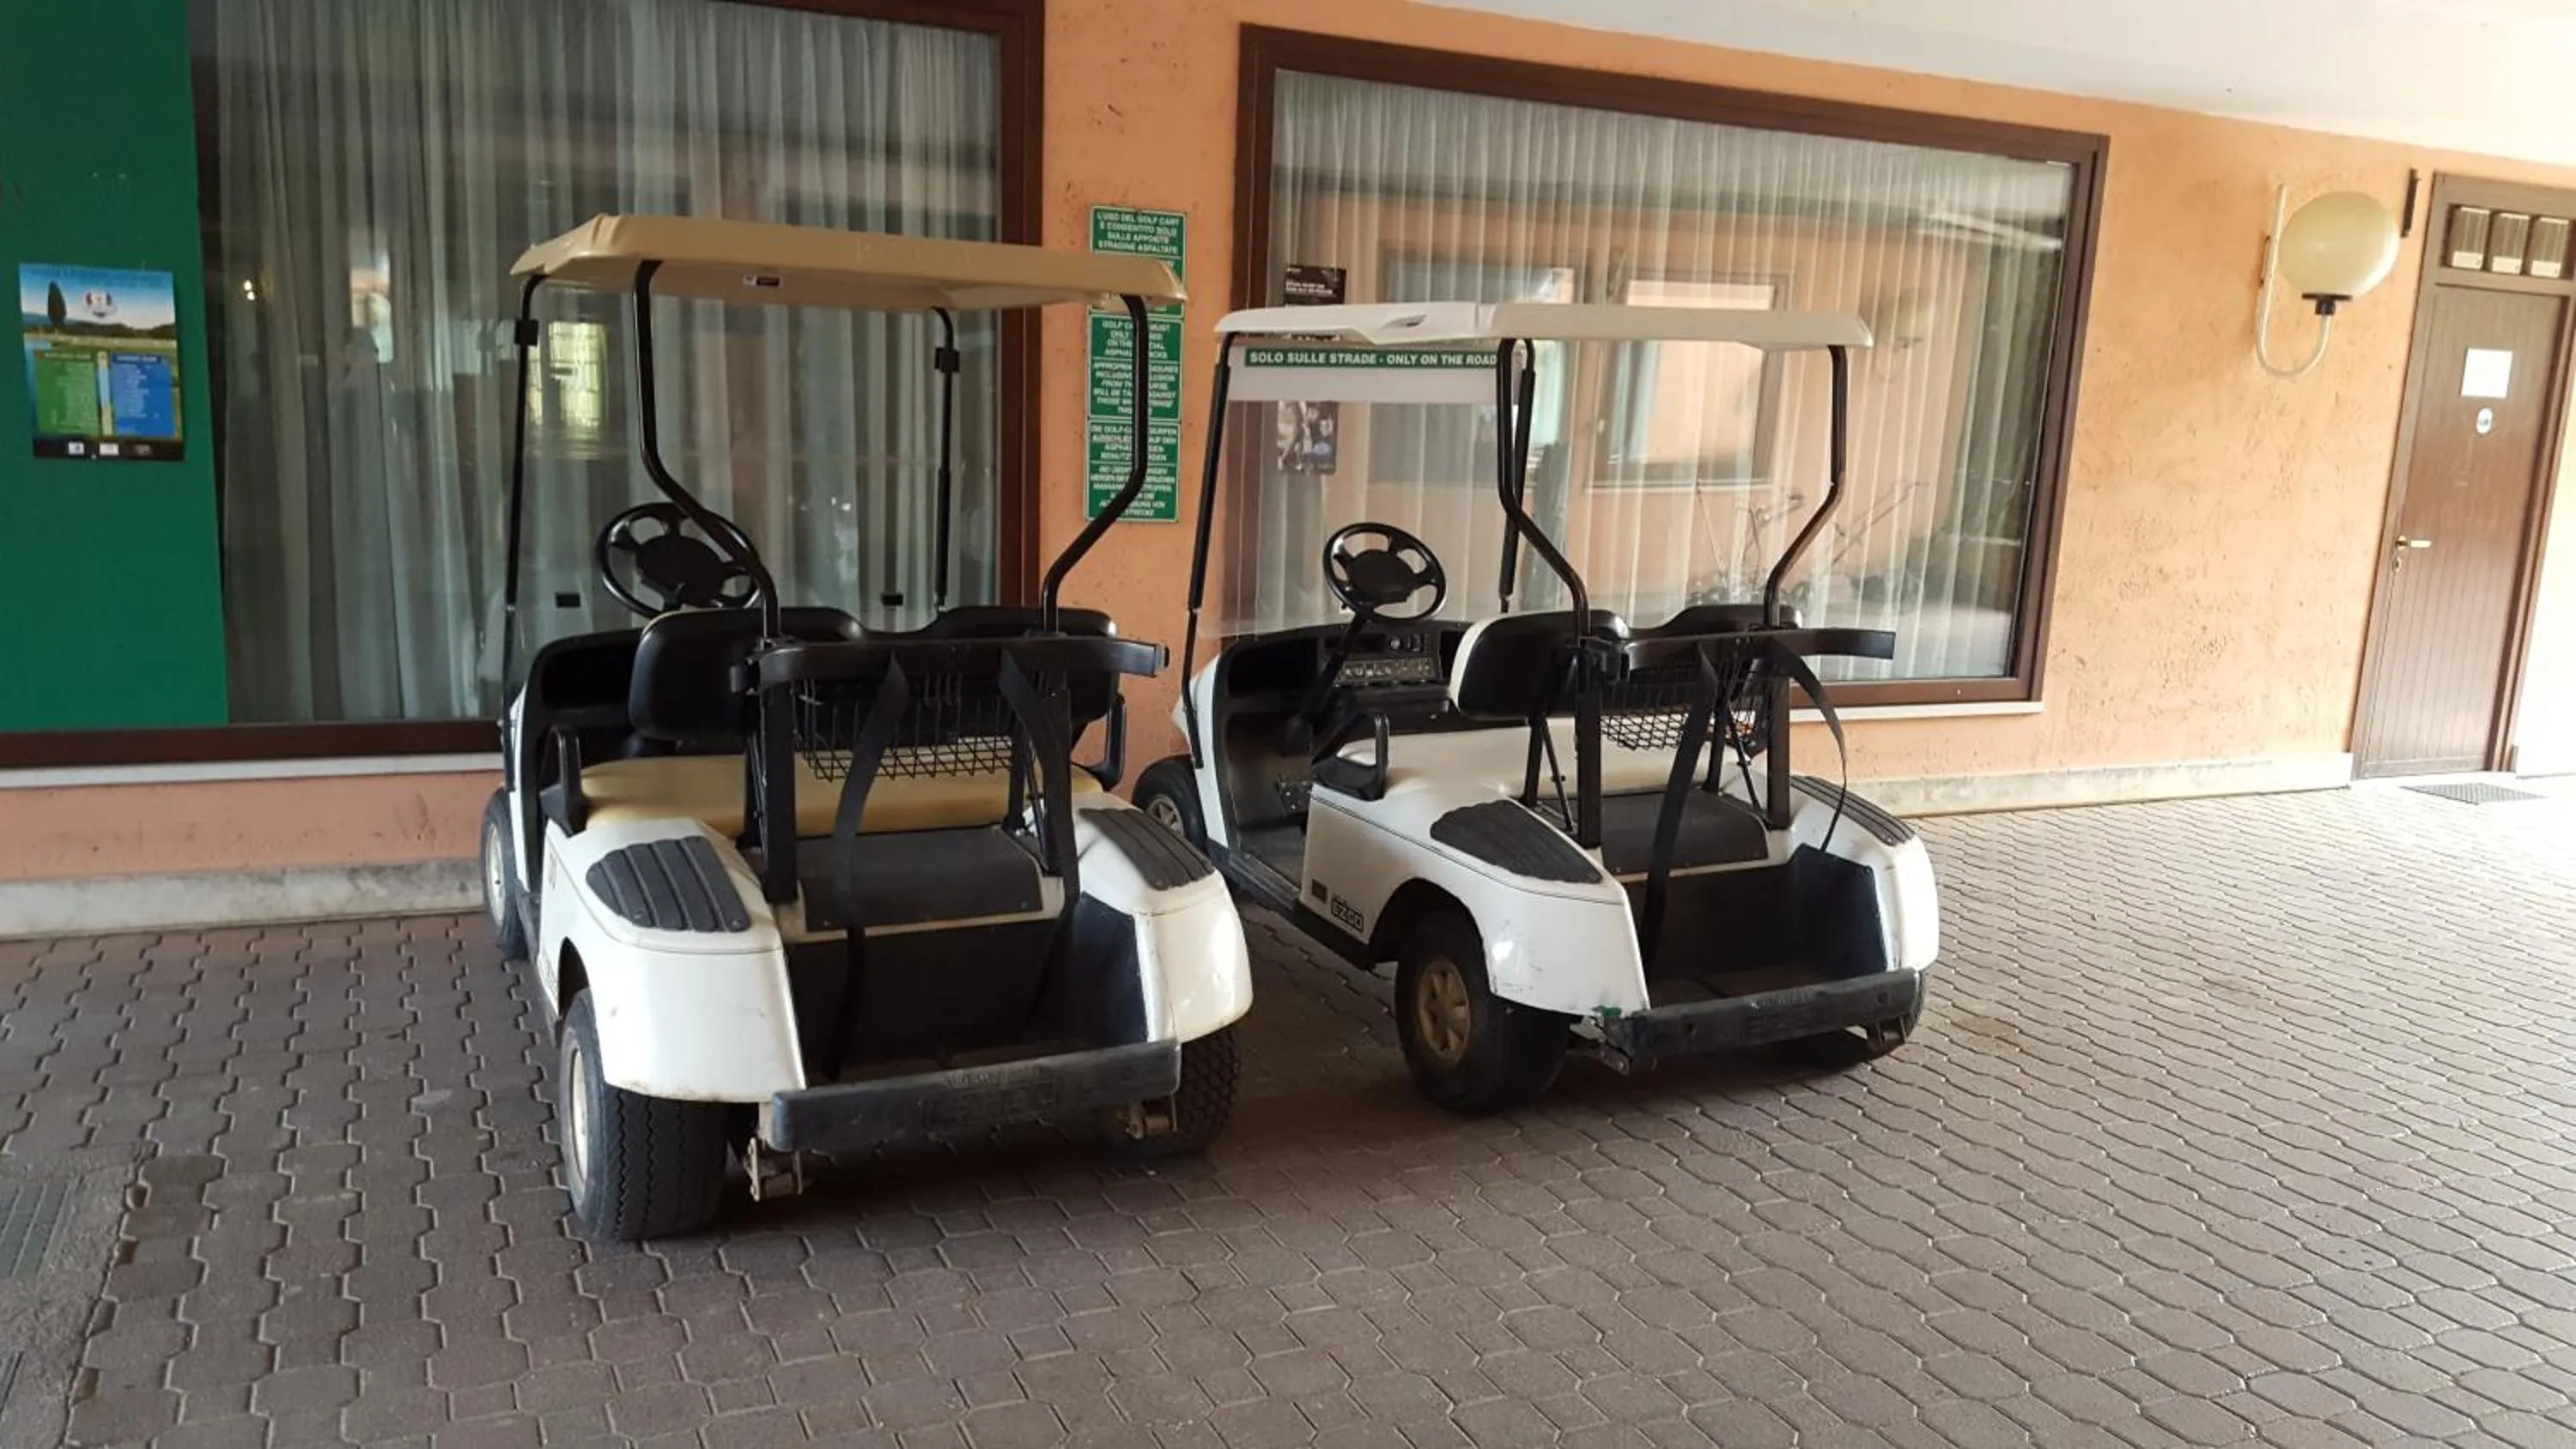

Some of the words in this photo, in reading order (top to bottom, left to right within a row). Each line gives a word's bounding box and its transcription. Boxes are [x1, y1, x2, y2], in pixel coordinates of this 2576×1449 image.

[1136, 215, 1157, 224] GOLF
[1159, 217, 1180, 227] CART
[1156, 227, 1177, 238] SOLO
[1250, 351, 1284, 363] SOLO
[1287, 352, 1326, 364] SULLE
[1329, 353, 1377, 365] STRADE
[1387, 353, 1418, 365] ONLY
[1420, 354, 1438, 365] ON
[1441, 354, 1463, 365] THE
[1466, 354, 1498, 366] ROAD
